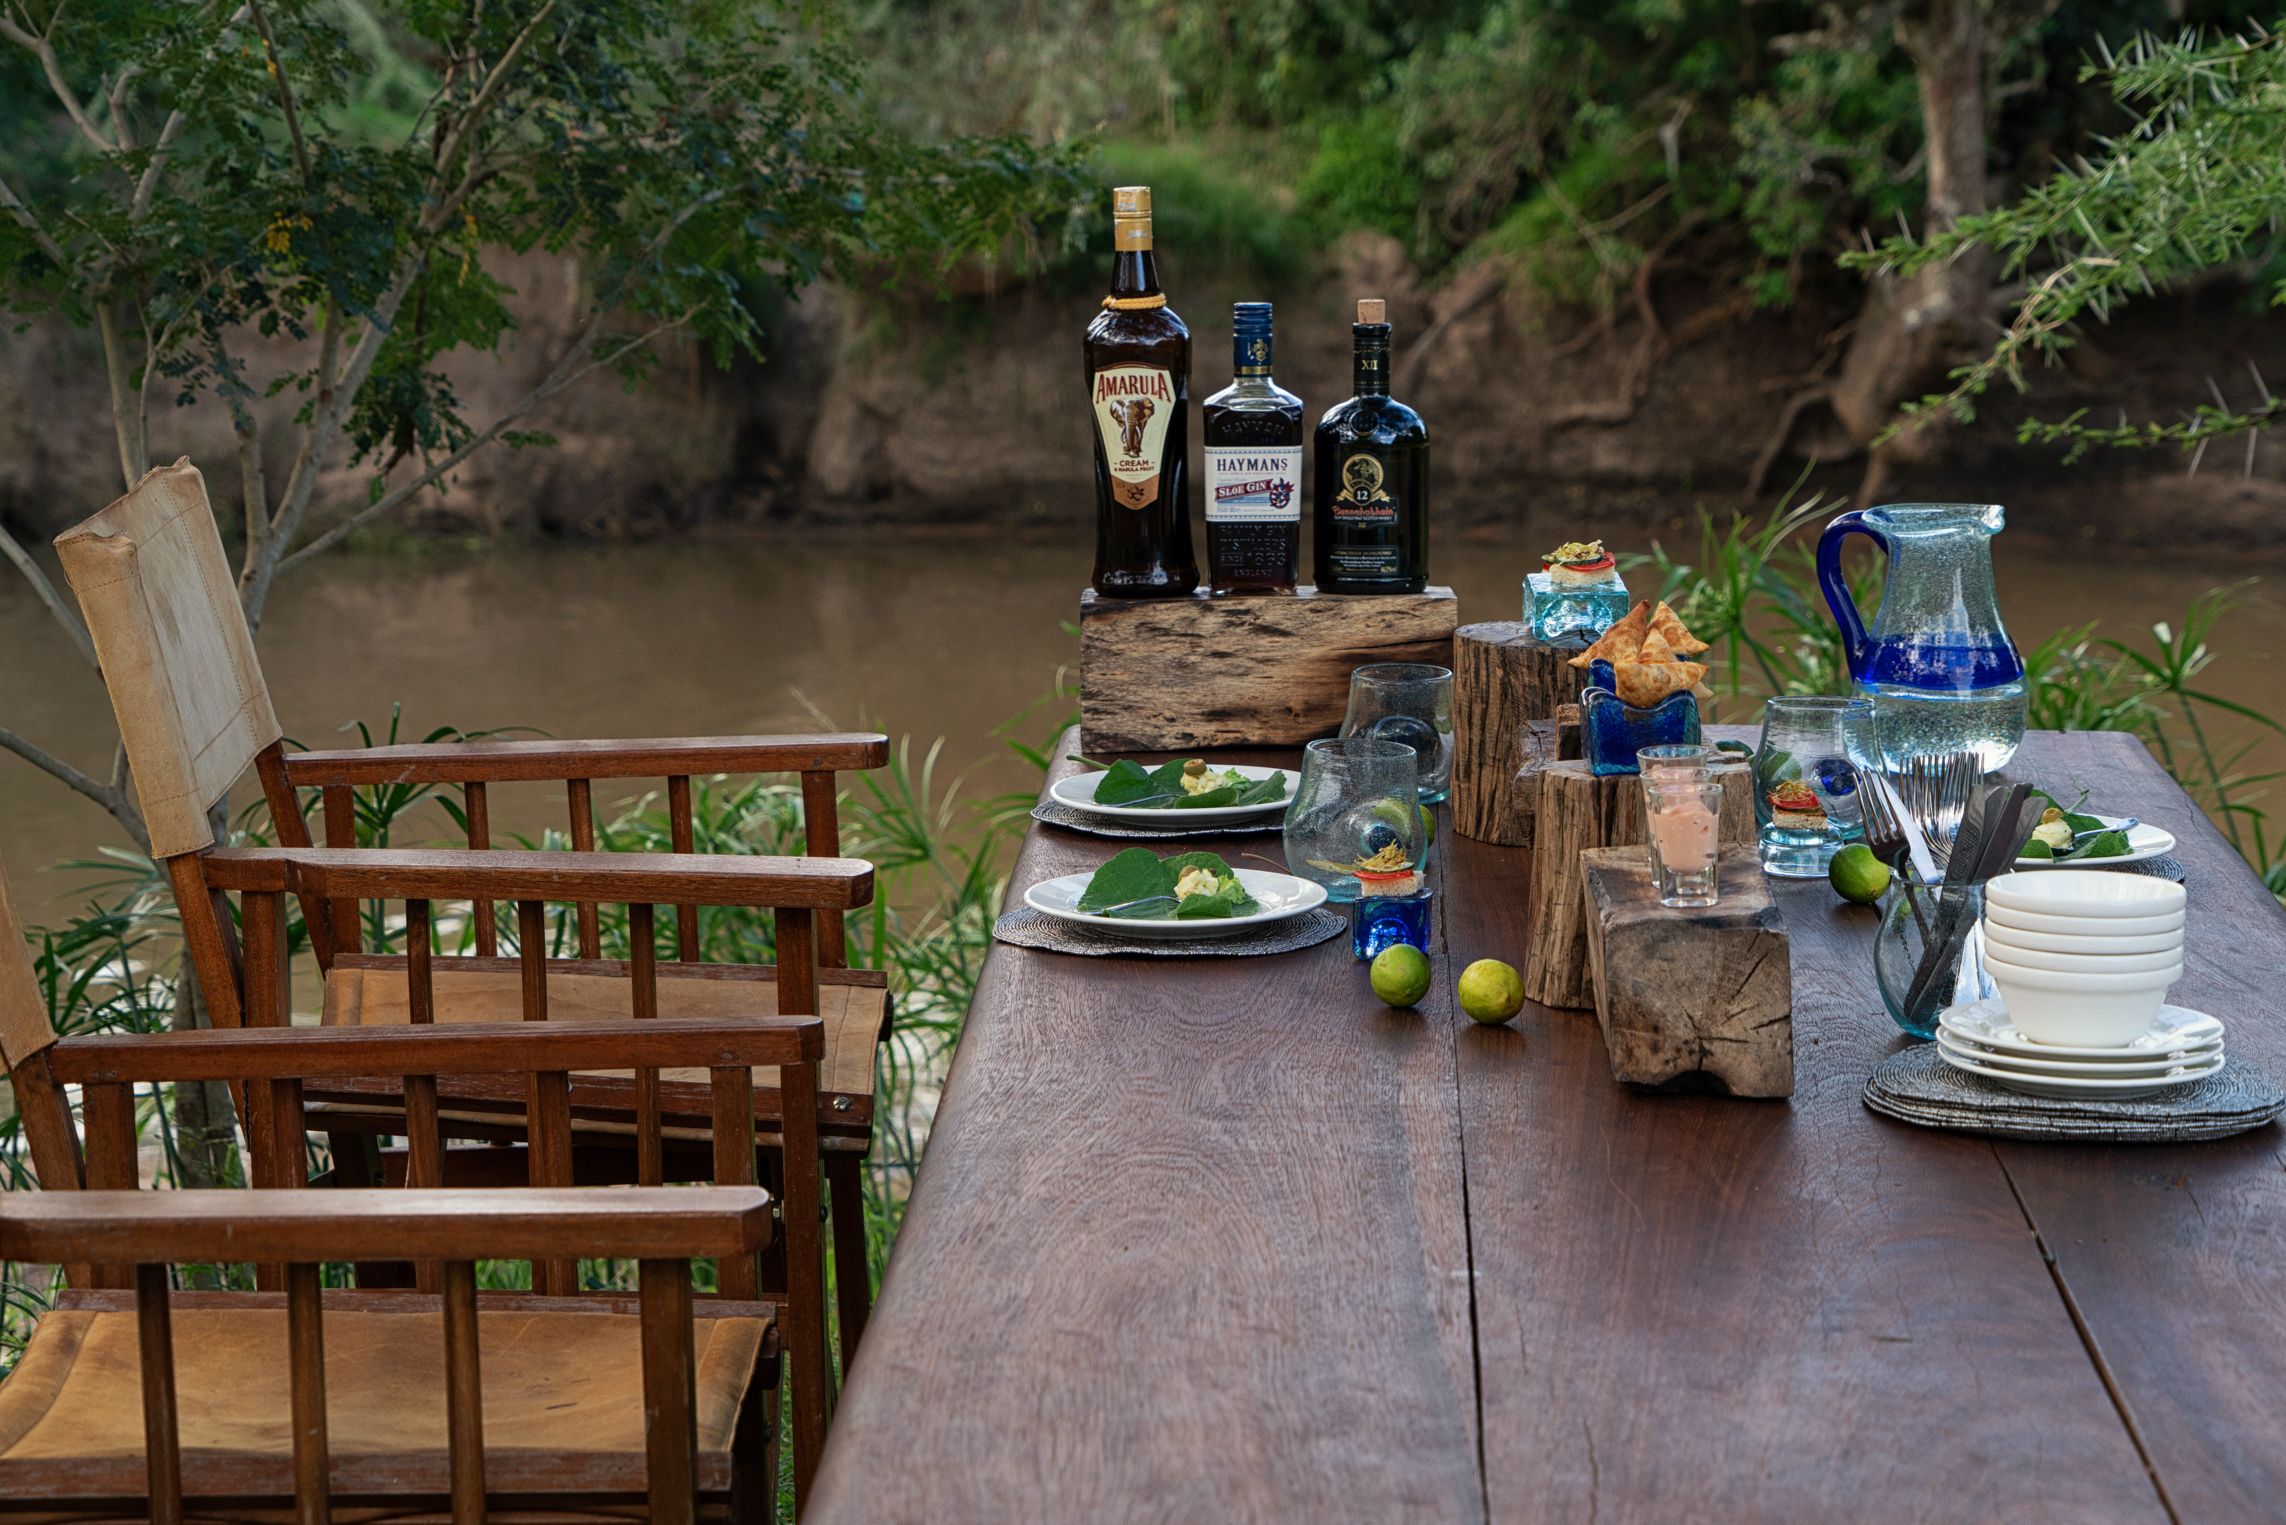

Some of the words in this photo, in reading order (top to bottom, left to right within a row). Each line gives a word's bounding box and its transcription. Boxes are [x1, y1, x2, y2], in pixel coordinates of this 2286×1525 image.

[1096, 372, 1172, 404] AMARULA
[1217, 458, 1288, 471] HAYMANS
[1218, 485, 1245, 497] SLOE
[1246, 481, 1267, 492] GIN
[1357, 490, 1369, 500] 12
